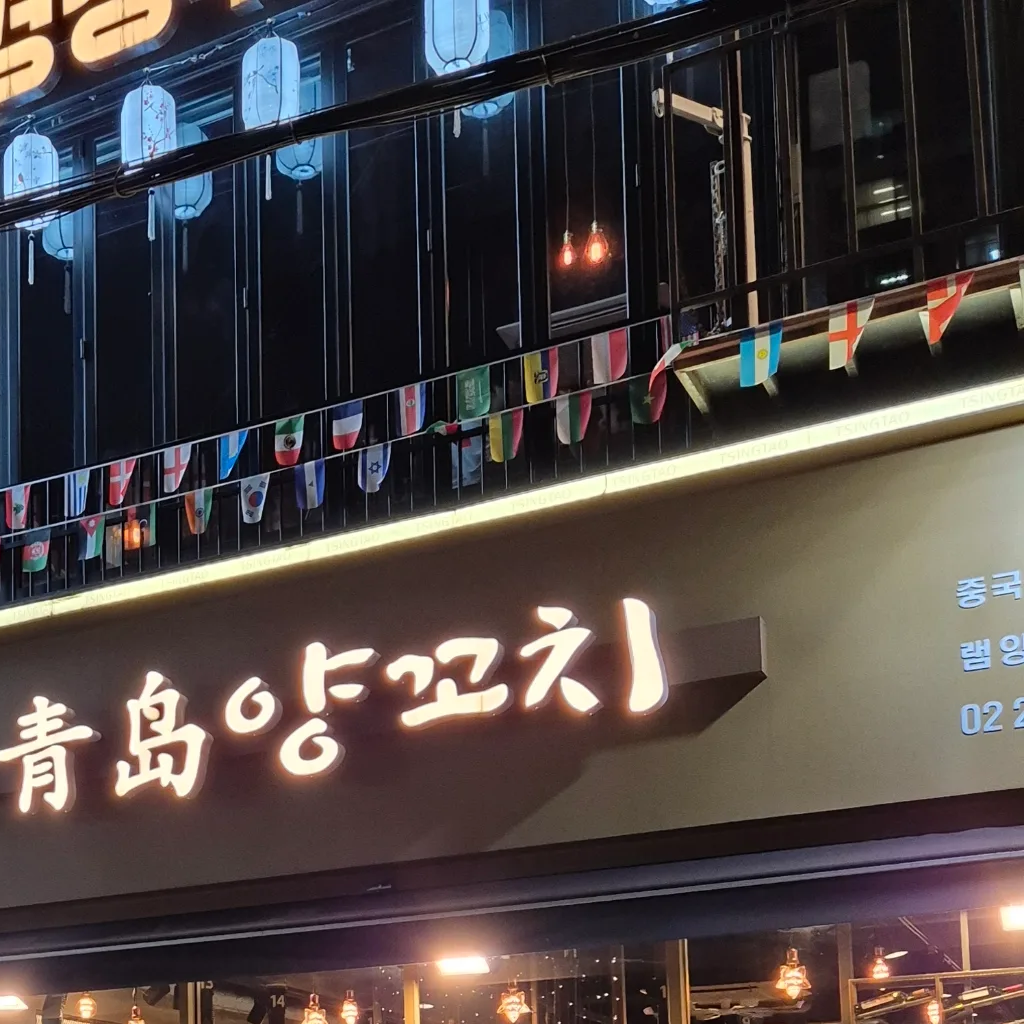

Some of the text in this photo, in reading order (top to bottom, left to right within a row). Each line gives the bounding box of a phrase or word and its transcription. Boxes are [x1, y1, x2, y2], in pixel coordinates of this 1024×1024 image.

[960, 638, 992, 672] 램
[961, 701, 1003, 735] 02
[269, 994, 286, 1008] 14
